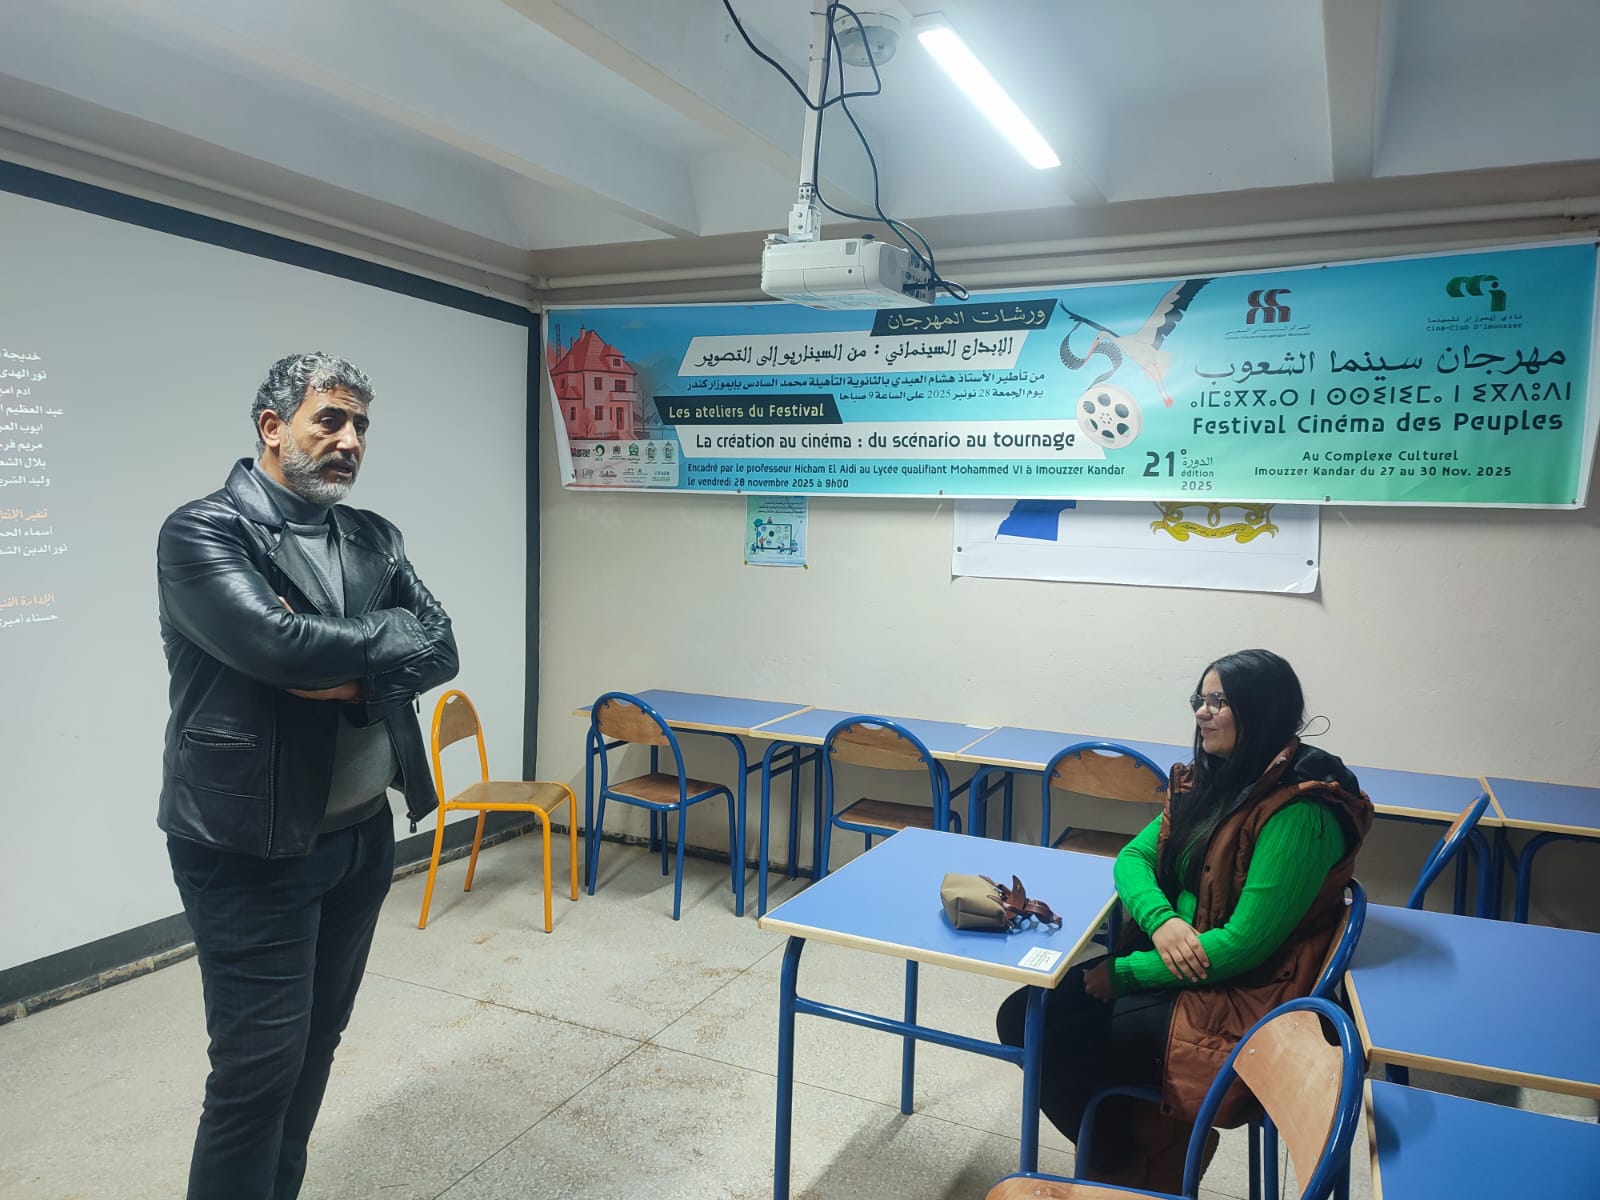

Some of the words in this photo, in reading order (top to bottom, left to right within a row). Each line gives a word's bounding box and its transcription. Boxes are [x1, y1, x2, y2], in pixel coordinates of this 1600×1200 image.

[887, 311, 965, 331] المهرجان
[971, 306, 1046, 326] ورشات
[783, 343, 843, 365] السيناريو
[846, 347, 867, 361] من
[885, 339, 957, 366] السينمائي
[962, 336, 1013, 361] الإبداع
[3, 348, 41, 363] خديجة
[694, 346, 752, 368] التصوير
[756, 345, 778, 367] إلى
[1436, 344, 1566, 376] مهرجان
[1194, 350, 1315, 386] الشعوب
[1330, 349, 1423, 382] سينما
[31, 370, 48, 382] نور
[928, 374, 956, 386] هشام
[957, 371, 995, 385] الأستاذ
[996, 370, 1028, 385] تأطير
[1029, 373, 1045, 384] من
[743, 378, 778, 390] السادس
[779, 379, 807, 388] محمد
[867, 391, 874, 401] 9
[874, 390, 905, 401] الساعة
[906, 390, 924, 401] على
[927, 389, 951, 399] 2025
[978, 388, 990, 398] 28
[992, 387, 1025, 400] الجمعة
[1026, 390, 1043, 400] يوم
[5, 404, 43, 416] العظيم
[45, 407, 64, 418] عبد
[668, 406, 690, 419] Les
[695, 405, 744, 419] ateliers
[748, 404, 764, 418] du
[769, 403, 824, 417] Festival
[1192, 414, 1286, 435] Festival
[1297, 414, 1385, 434] Cinéma
[1396, 411, 1442, 432] des
[1453, 409, 1563, 436] Peuples
[17, 441, 43, 453] مريم
[696, 433, 712, 449] La
[716, 433, 775, 448] création
[779, 436, 796, 448] au
[801, 432, 852, 448] cinéma
[857, 437, 863, 448] :
[867, 431, 887, 448] du
[892, 431, 961, 448] scénario
[966, 434, 987, 448] au
[993, 431, 1076, 451] tournage
[1182, 456, 1213, 469] الدورة
[1302, 451, 1320, 462] Au
[1324, 450, 1393, 464] Complexe
[1398, 449, 1459, 461] Culturel
[24, 457, 47, 470] بلال
[687, 463, 718, 473] Encadré
[720, 465, 733, 475] par
[735, 463, 744, 473] le
[746, 463, 792, 475] professeur
[794, 463, 826, 474] Hicham
[828, 464, 838, 474] El
[839, 464, 857, 474] Aidi
[859, 465, 871, 475] au
[873, 464, 898, 477] Lycée
[901, 464, 947, 477] qualifiant
[950, 464, 1009, 475] Mohammed
[1012, 464, 1023, 475] VI
[1025, 463, 1032, 475] à
[1035, 464, 1083, 475] Imouzzer
[1087, 464, 1126, 476] Kandar
[1180, 467, 1214, 478] édition
[1254, 466, 1309, 477] Imouzzer
[1313, 466, 1356, 477] Kandar
[1359, 466, 1375, 477] du
[1379, 466, 1395, 477] 27
[1399, 467, 1415, 477] au
[1420, 466, 1437, 477] 30
[1441, 466, 1472, 477] Nov.
[1475, 466, 1512, 477] 2025
[28, 475, 51, 487] وليد
[687, 477, 696, 487] le
[698, 477, 732, 487] vendredi
[734, 478, 745, 487] 28
[747, 477, 789, 488] novembre
[791, 478, 815, 488] 2025
[816, 478, 823, 488] à
[825, 478, 849, 489] 9h00
[1180, 480, 1213, 491] 2025
[23, 544, 51, 557] الدين
[52, 543, 68, 556] نور
[25, 613, 58, 624] حسناء
